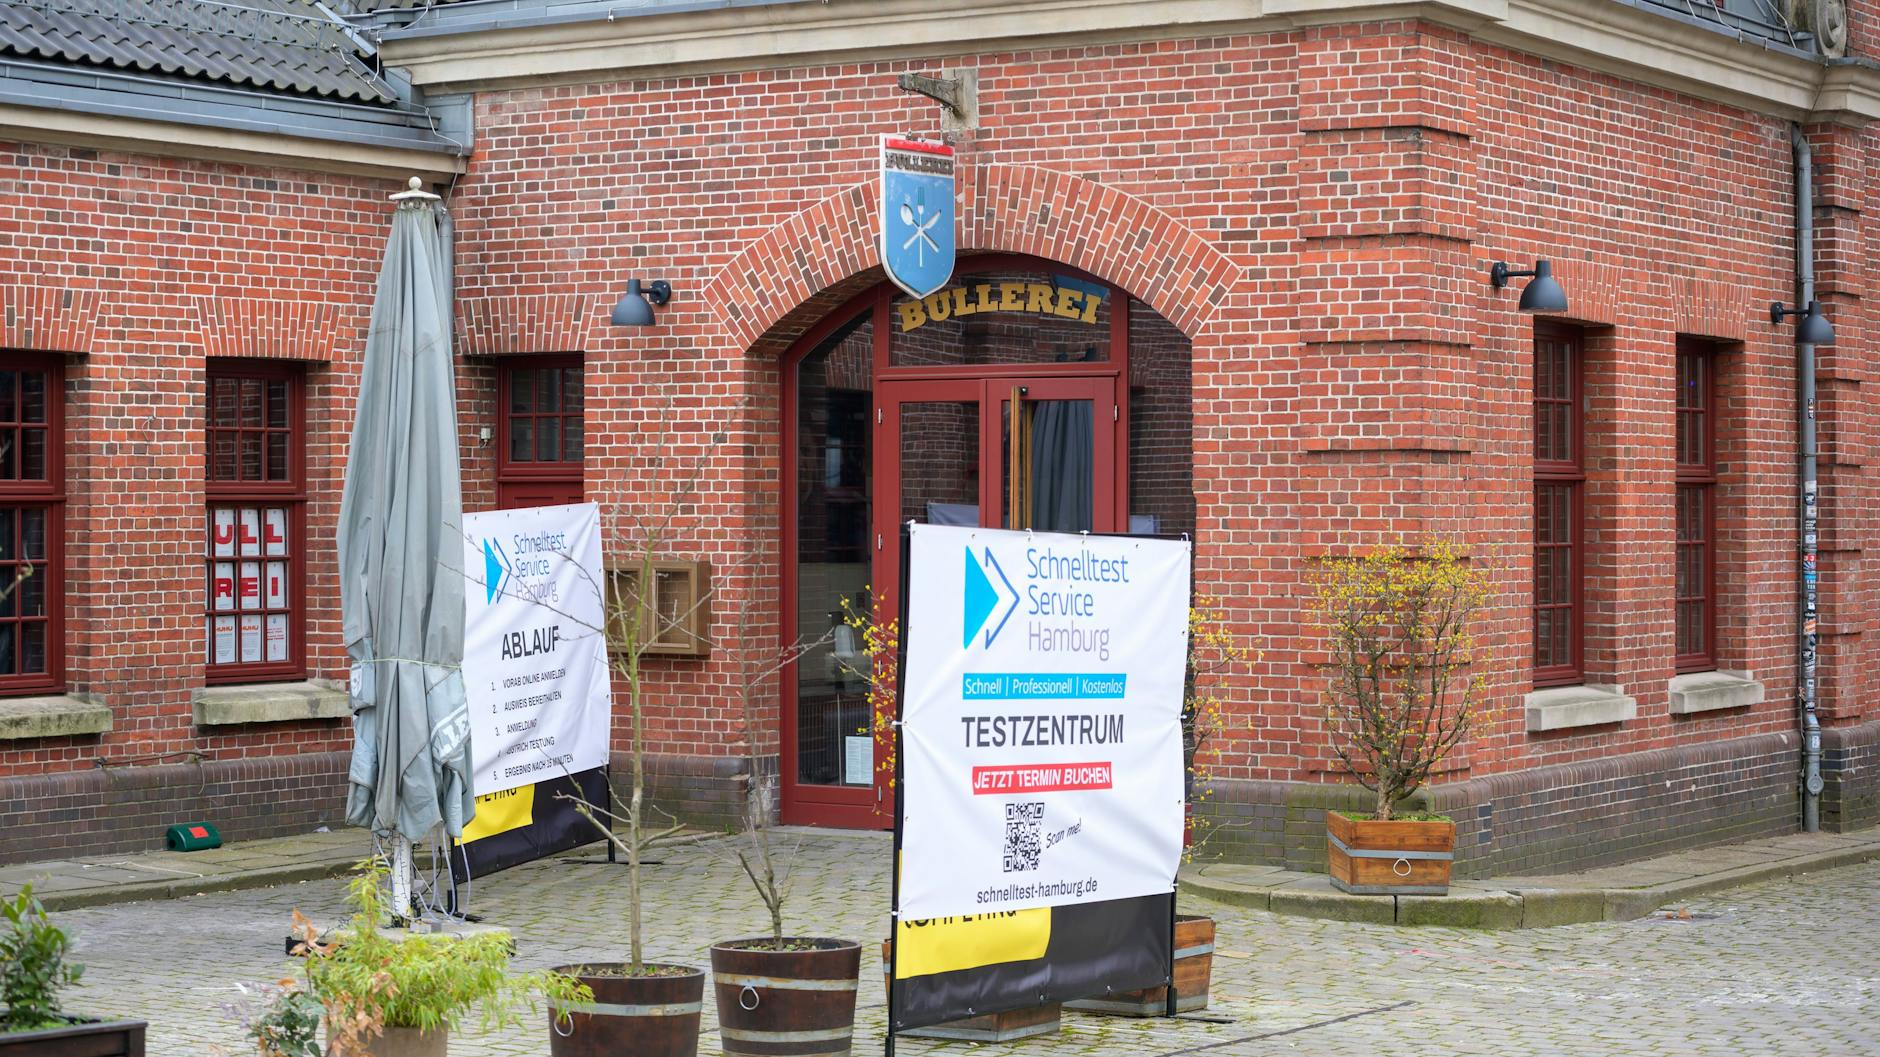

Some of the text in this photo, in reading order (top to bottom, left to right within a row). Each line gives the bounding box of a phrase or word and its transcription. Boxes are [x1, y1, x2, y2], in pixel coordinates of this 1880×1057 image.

[898, 283, 1102, 332] BULLEREI
[514, 530, 567, 554] Schnelltest
[515, 555, 550, 578] Service
[1026, 547, 1130, 583] Schnelltest
[516, 577, 559, 602] Hamburg
[1028, 584, 1094, 617] Service
[502, 626, 560, 661] ABLAUF
[1028, 620, 1110, 662] Hamburg
[502, 676, 521, 688] VORAB
[522, 673, 540, 685] ONLINE
[541, 668, 566, 681] ANMELDEN
[965, 677, 1124, 695] Schnell Professionell Kostenlos
[504, 698, 528, 711] AUSWEIS
[507, 718, 537, 733] ANMELDUNG
[961, 714, 1124, 748] TESTZENTRUM
[529, 736, 554, 750] TESTUNG
[505, 763, 531, 777] ERGEBNIS
[532, 760, 546, 771] NACH
[974, 767, 1110, 790] JETZT TERMIN BUCHEN
[1046, 818, 1082, 849] Scan me!
[976, 876, 1098, 904] schnelltest-hamburg.de
